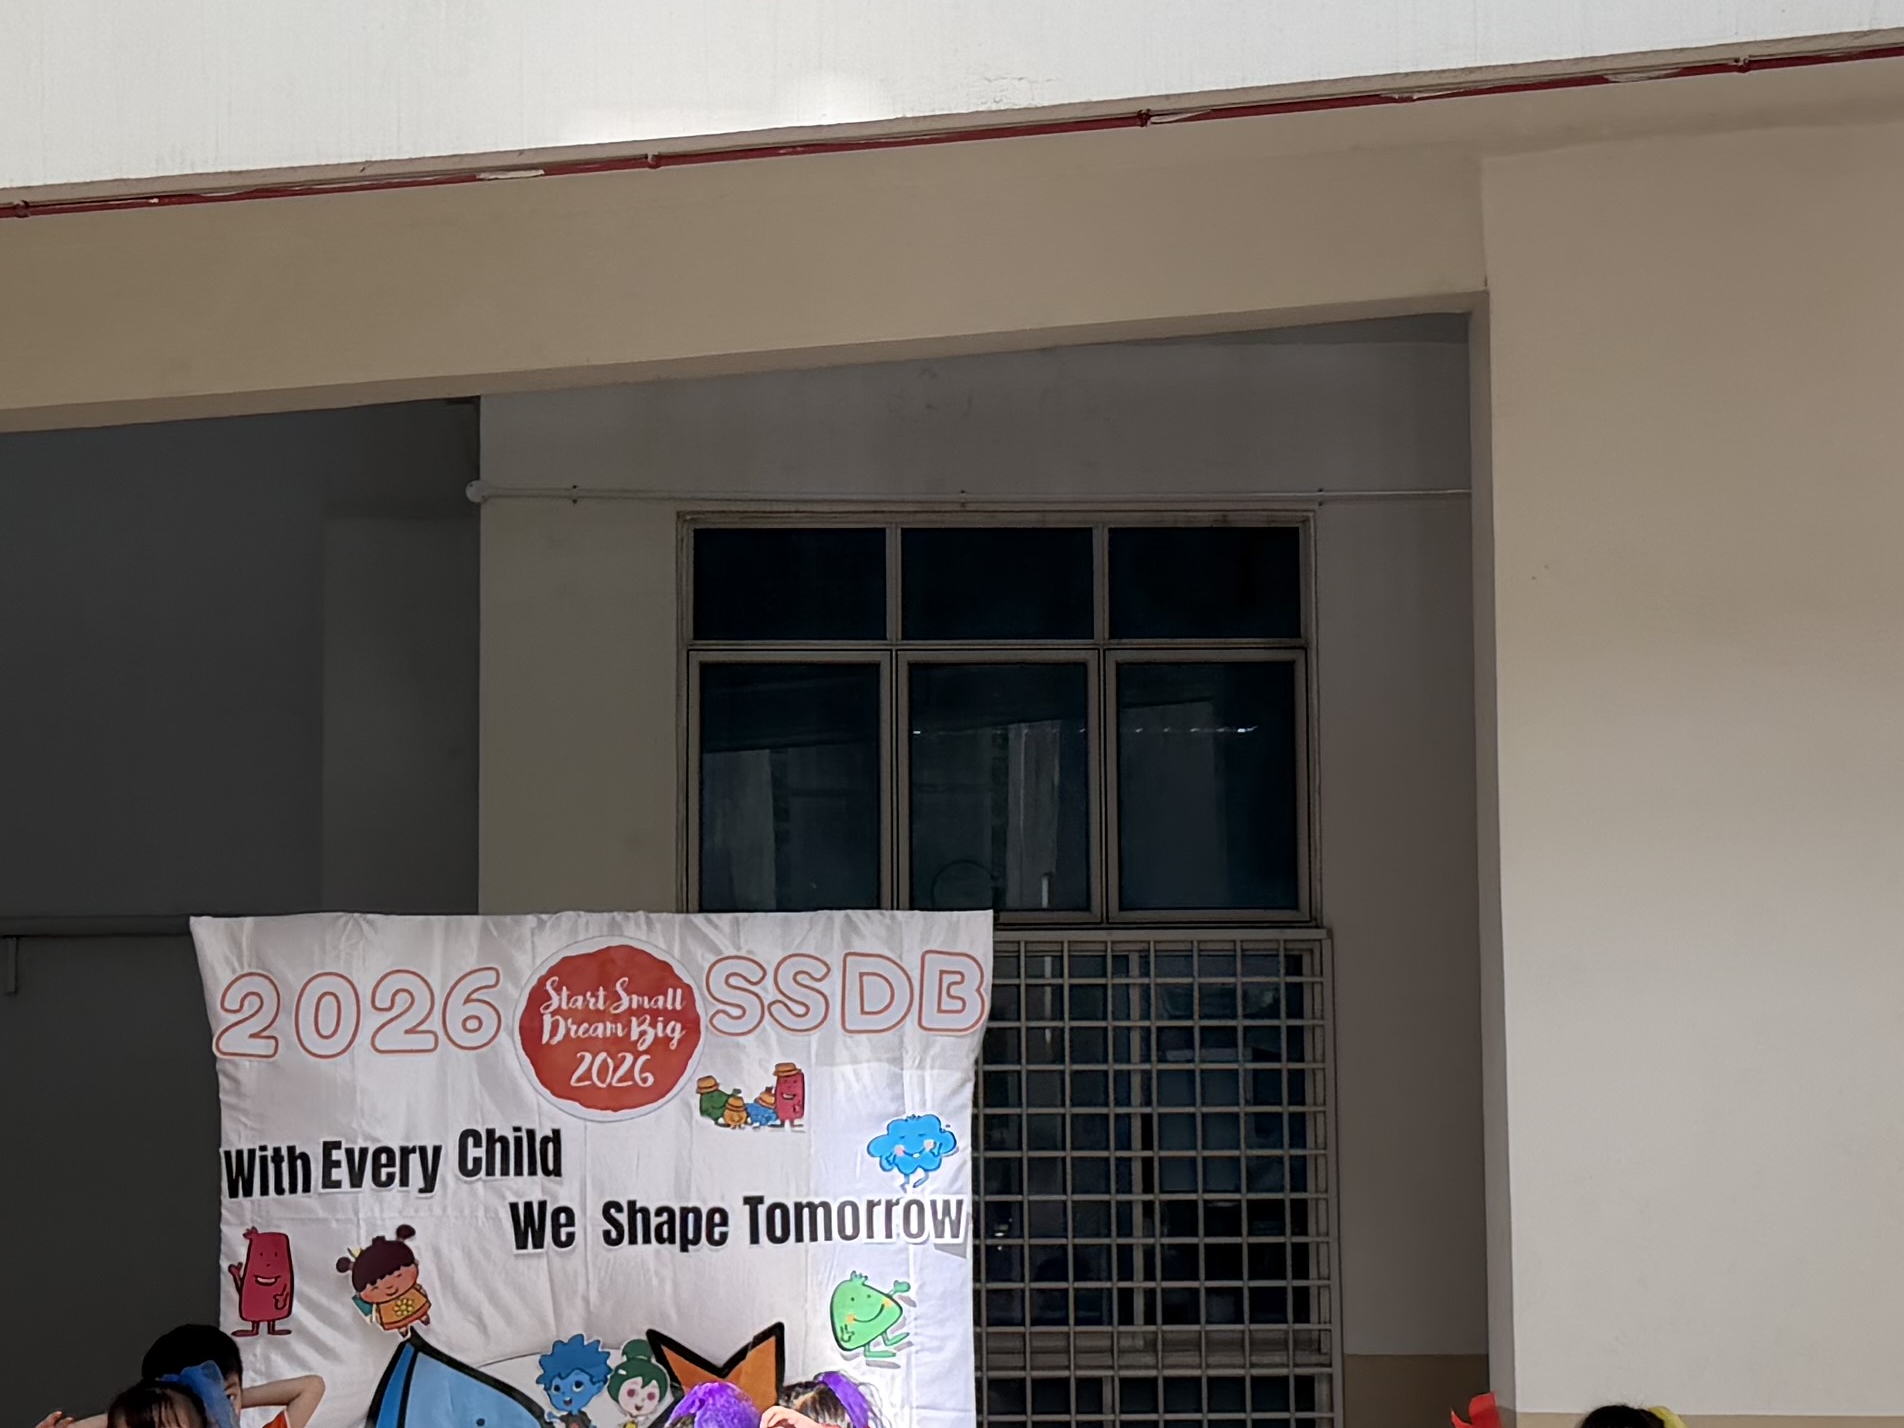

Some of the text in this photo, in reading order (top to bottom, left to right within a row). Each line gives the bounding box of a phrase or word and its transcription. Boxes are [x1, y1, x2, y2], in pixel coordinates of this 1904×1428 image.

[214, 948, 986, 1060] 2026 SSDB
[539, 976, 685, 1014] Start Small
[541, 1013, 686, 1051] Dream Big
[569, 1051, 655, 1088] 2026
[223, 1126, 563, 1199] With Every Child
[508, 1194, 965, 1253] We Shape Tomorrow
